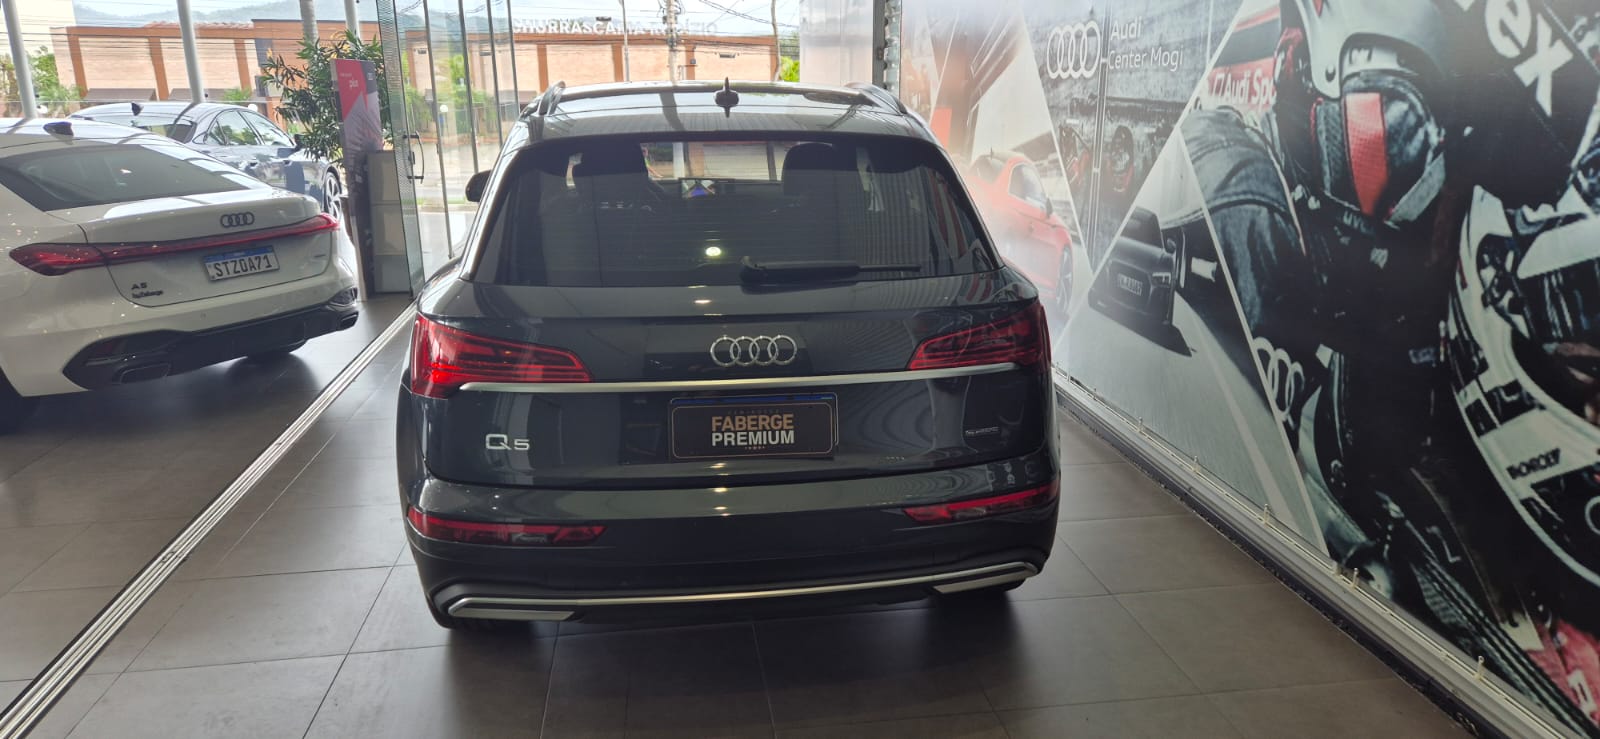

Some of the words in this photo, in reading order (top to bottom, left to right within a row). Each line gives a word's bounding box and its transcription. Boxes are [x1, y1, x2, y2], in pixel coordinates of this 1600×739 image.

[1110, 16, 1142, 40] Audi
[1107, 50, 1148, 70] Center
[1150, 47, 1184, 71] Mogi
[1223, 70, 1250, 104] Audi
[711, 413, 795, 432] FABERGE
[485, 433, 530, 450] Q5
[711, 430, 795, 447] PREMIUM
